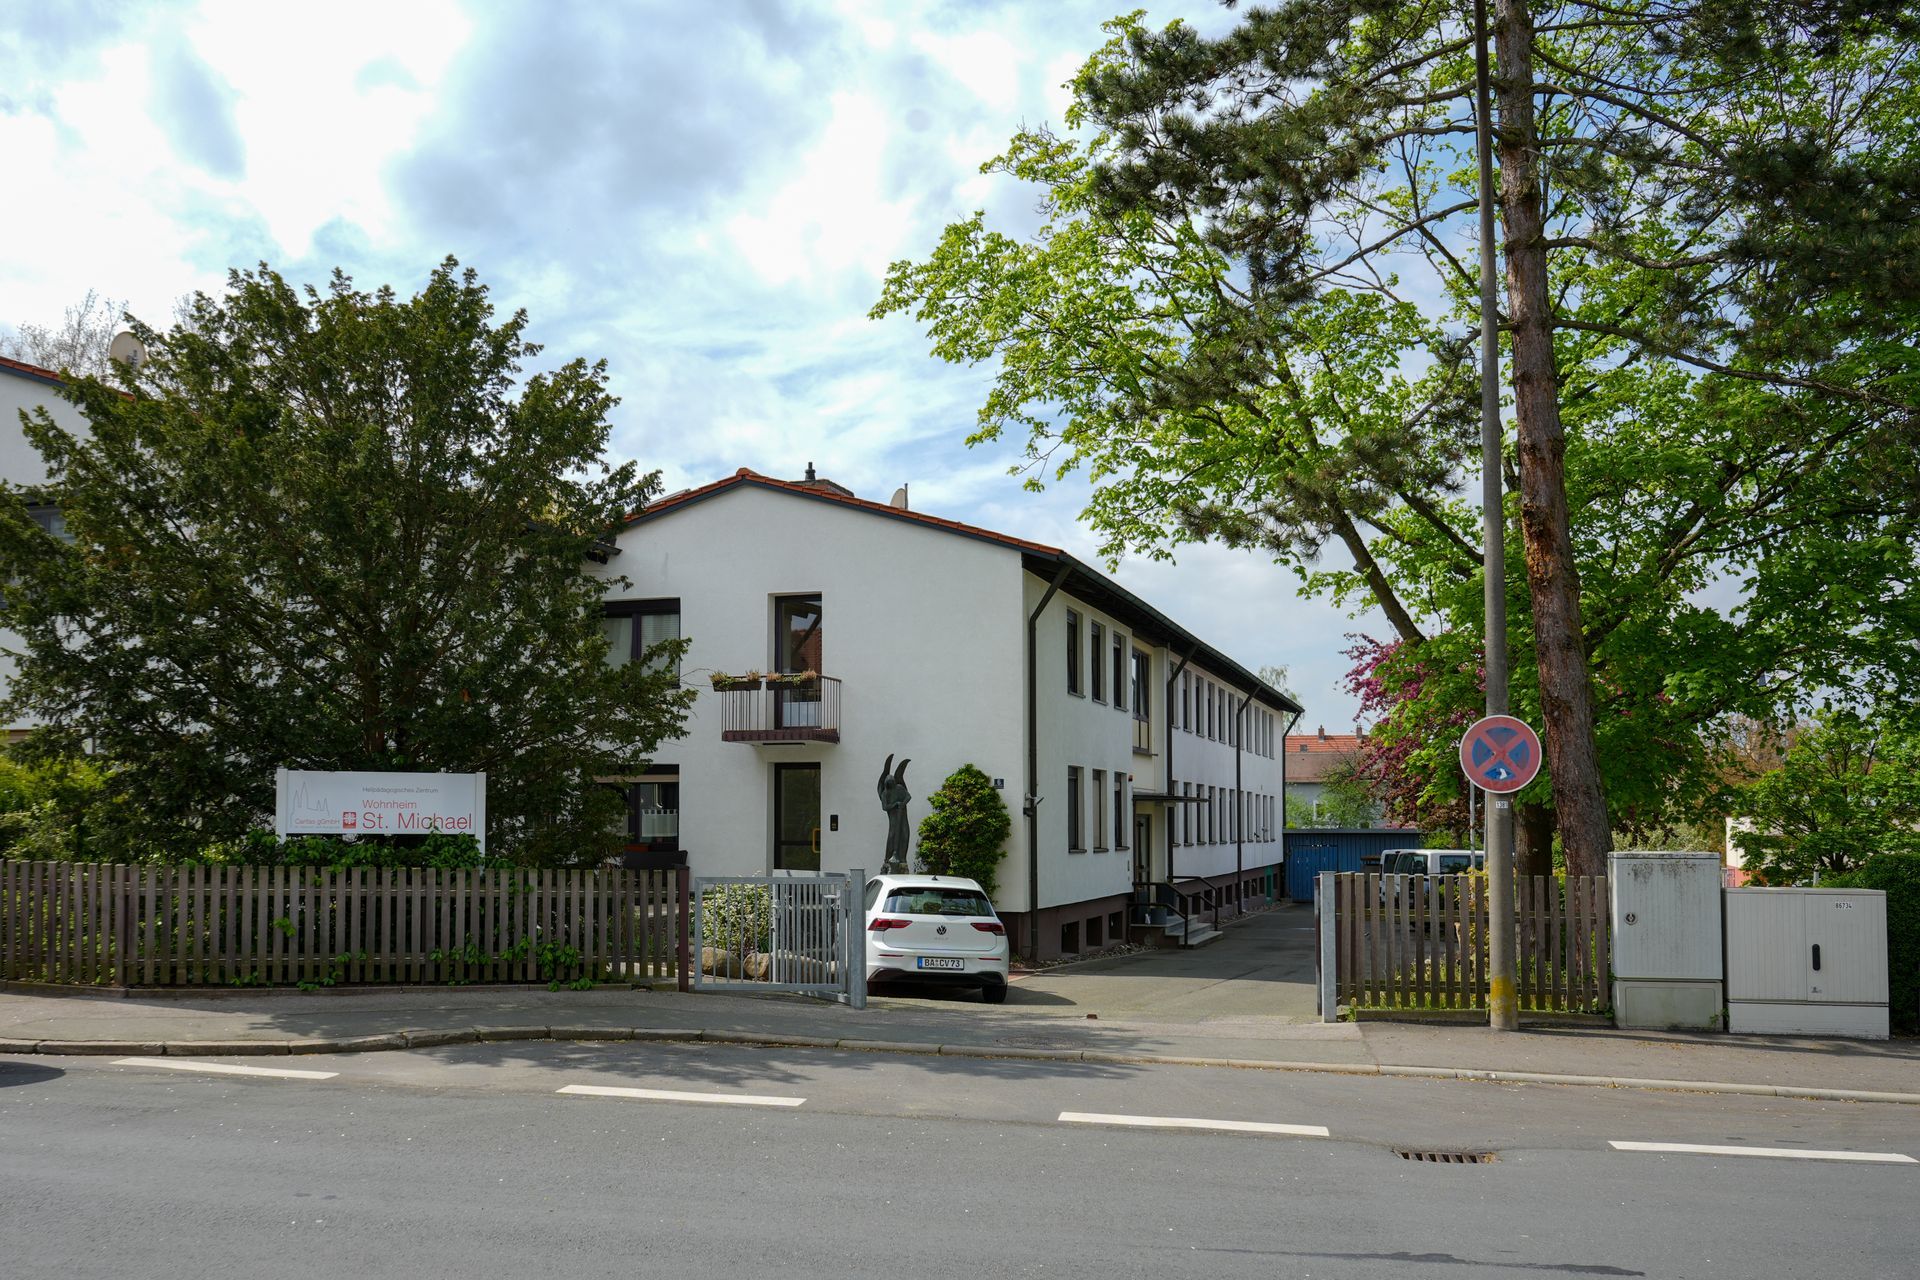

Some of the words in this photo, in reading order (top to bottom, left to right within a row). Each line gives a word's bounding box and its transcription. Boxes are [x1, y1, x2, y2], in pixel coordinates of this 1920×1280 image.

[362, 800, 417, 809] Wohnheim
[362, 812, 388, 830] St.
[398, 812, 472, 830] Michael
